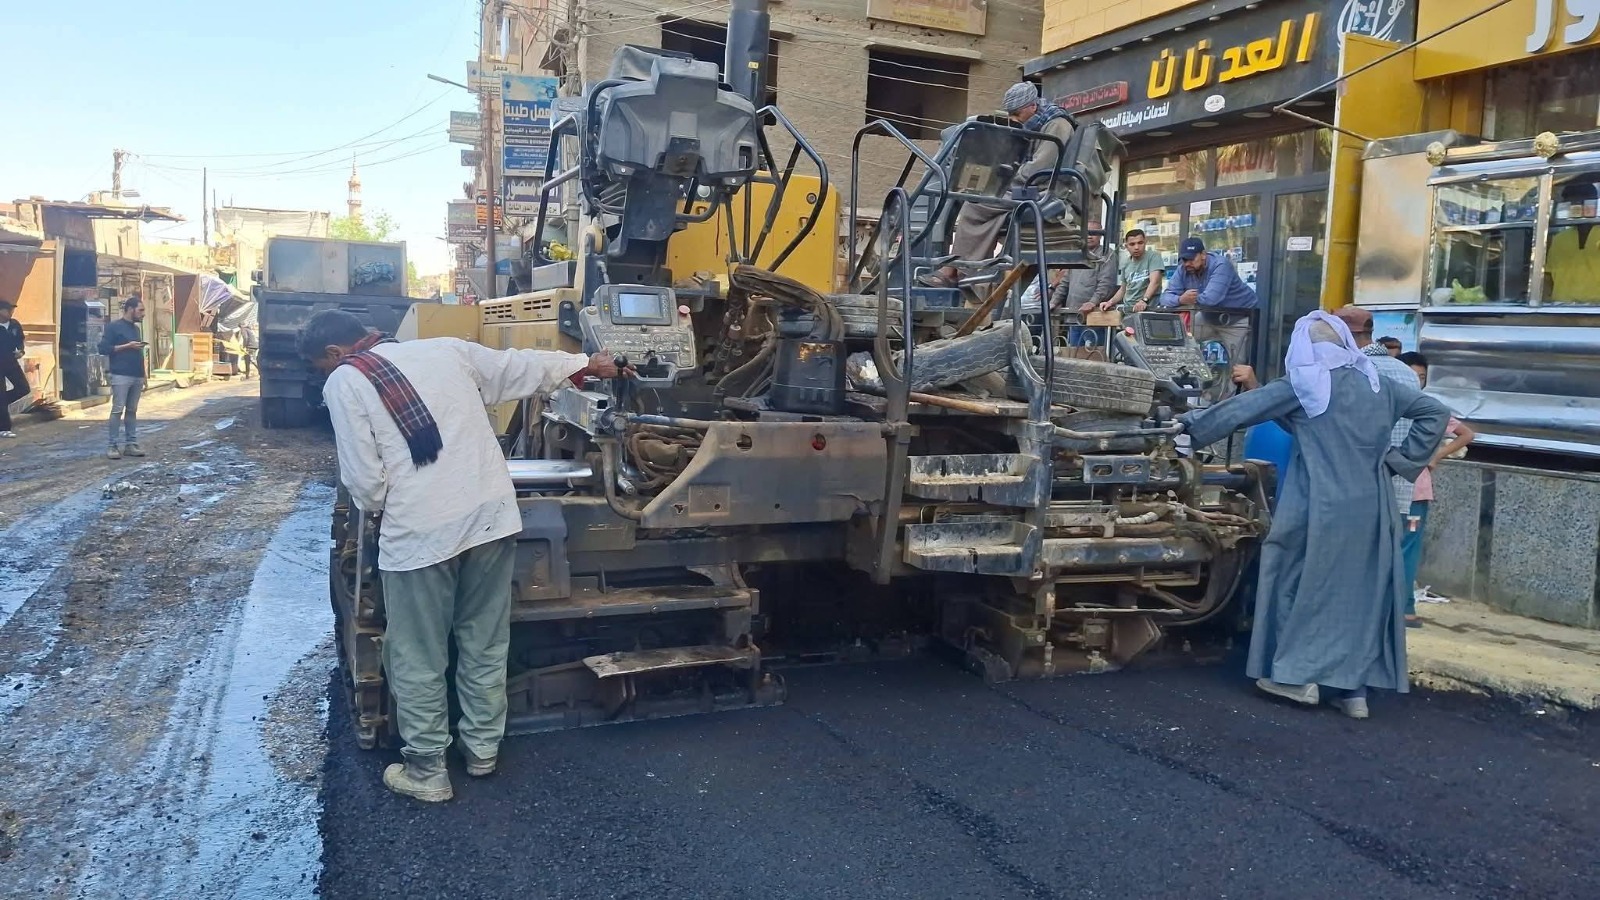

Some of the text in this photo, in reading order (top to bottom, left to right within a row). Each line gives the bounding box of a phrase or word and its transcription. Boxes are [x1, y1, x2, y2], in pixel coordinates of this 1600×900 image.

[1146, 12, 1321, 99] العدنان
[1121, 110, 1143, 128] وصيانة
[1143, 101, 1170, 120] لخدمات
